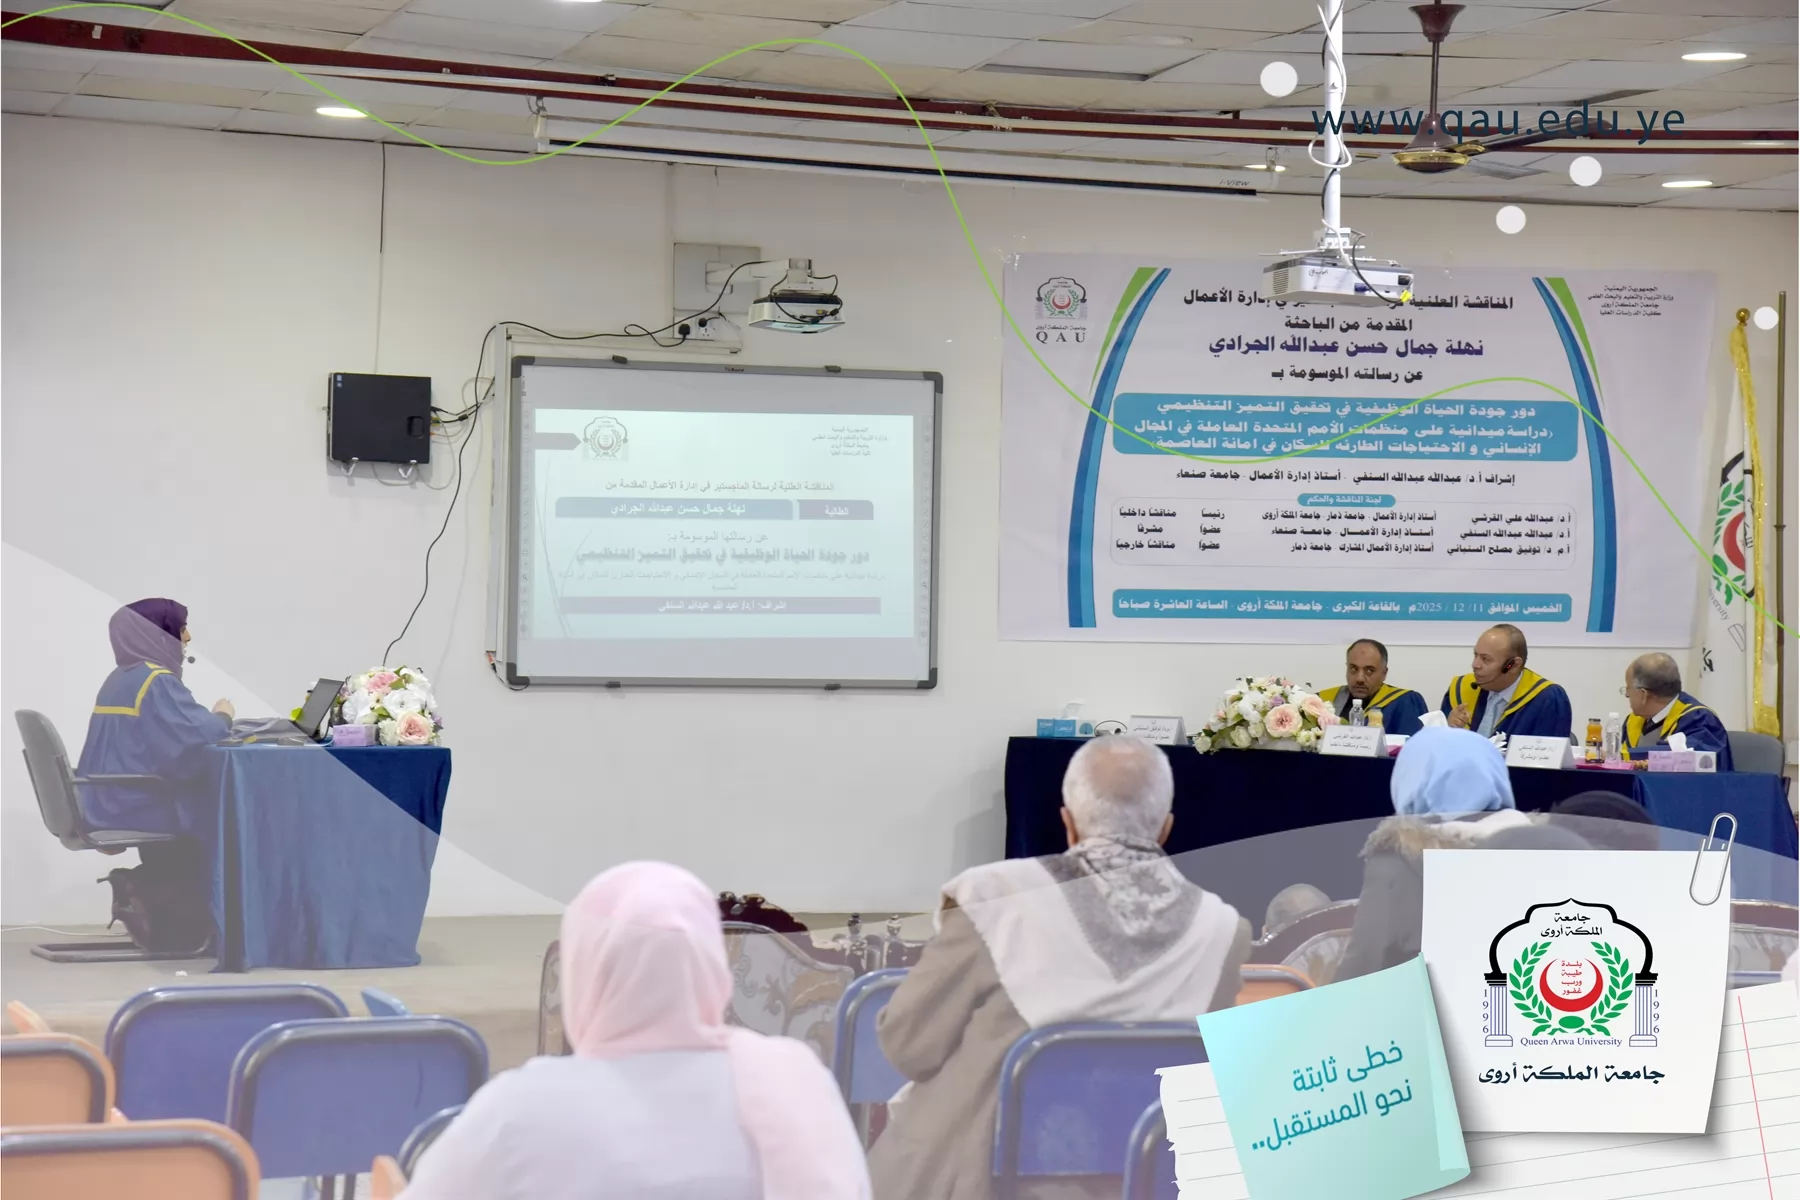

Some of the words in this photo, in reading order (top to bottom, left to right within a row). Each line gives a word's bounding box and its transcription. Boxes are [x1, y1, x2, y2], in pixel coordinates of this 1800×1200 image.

[1184, 287, 1232, 304] الأعمال
[1409, 294, 1458, 307] العلنية
[1463, 296, 1513, 309] المناقشة
[1285, 316, 1334, 332] الباحثة
[1340, 321, 1360, 333] من
[1367, 319, 1412, 331] المقدمة
[1209, 335, 1274, 357] الجرادي
[1280, 335, 1339, 356] عبدالله
[1346, 342, 1388, 357] حسن
[1396, 339, 1438, 358] جمال
[1446, 340, 1483, 355] نهلة
[1290, 367, 1348, 382] الموسومة
[1354, 368, 1399, 383] رسالته
[1404, 371, 1422, 383] عن
[1157, 399, 1231, 414] التنظيمي
[1236, 401, 1284, 413] التميز
[1290, 402, 1331, 414] تحقيق
[1336, 402, 1350, 418] في
[1424, 404, 1464, 417] الحياة
[1469, 405, 1506, 418] جودة
[1511, 408, 1535, 418] دور
[1135, 420, 1172, 433] المجال
[1178, 420, 1192, 436] في
[1197, 421, 1247, 432] العاملة
[1253, 422, 1301, 433] المتحدة
[1308, 421, 1343, 436] الأمم
[1415, 425, 1443, 437] على
[1449, 425, 1505, 438] ميدانية
[1222, 438, 1257, 449] امانة
[1262, 438, 1276, 454] في
[1388, 441, 1465, 454] الاحتياجات
[1469, 441, 1478, 455] و
[1483, 443, 1540, 456] الإنساني
[1177, 469, 1206, 478] صنعاء
[1210, 471, 1240, 480] جامعة
[1250, 471, 1283, 481] الأعمال
[1287, 471, 1310, 482] إدارة
[1314, 472, 1340, 480] أستاذ
[1353, 473, 1388, 483] السنفي
[1392, 472, 1424, 481] عبدالله
[1428, 473, 1461, 484] عبدالله
[1485, 475, 1515, 485] إشراف
[1262, 511, 1278, 520] أروى
[1327, 512, 1341, 521] ذمار
[1344, 510, 1365, 521] جامعة
[1373, 513, 1396, 521] الأعمال
[1399, 513, 1415, 522] إدارة
[1417, 511, 1437, 522] أستاذ
[1472, 514, 1502, 523] القرشي
[1506, 515, 1522, 523] علي
[1525, 514, 1553, 522] عبدالله
[1382, 528, 1401, 537] إدارة
[1460, 530, 1491, 538] السنفي
[1493, 529, 1522, 537] عبدالله
[1525, 528, 1553, 539] عبدالله
[1291, 544, 1307, 552] ذمار
[1310, 544, 1331, 552] جامعة
[1339, 544, 1364, 552] المشارك
[1367, 544, 1392, 553] الأعمال
[1395, 544, 1411, 553] إدارة
[1414, 543, 1434, 553] أستاذ
[1447, 545, 1485, 554] السنباني
[1489, 546, 1512, 554] مصلح
[1517, 547, 1540, 555] توفيق
[1154, 600, 1192, 611] العاشرة
[1196, 600, 1227, 609] الساعة
[1237, 598, 1260, 611] أروى
[1264, 600, 1288, 609] الملكة
[1291, 601, 1322, 612] جامعة
[1333, 601, 1365, 612] الكبرى
[1488, 603, 1518, 614] الموافق
[1523, 604, 1561, 614] الخميس
